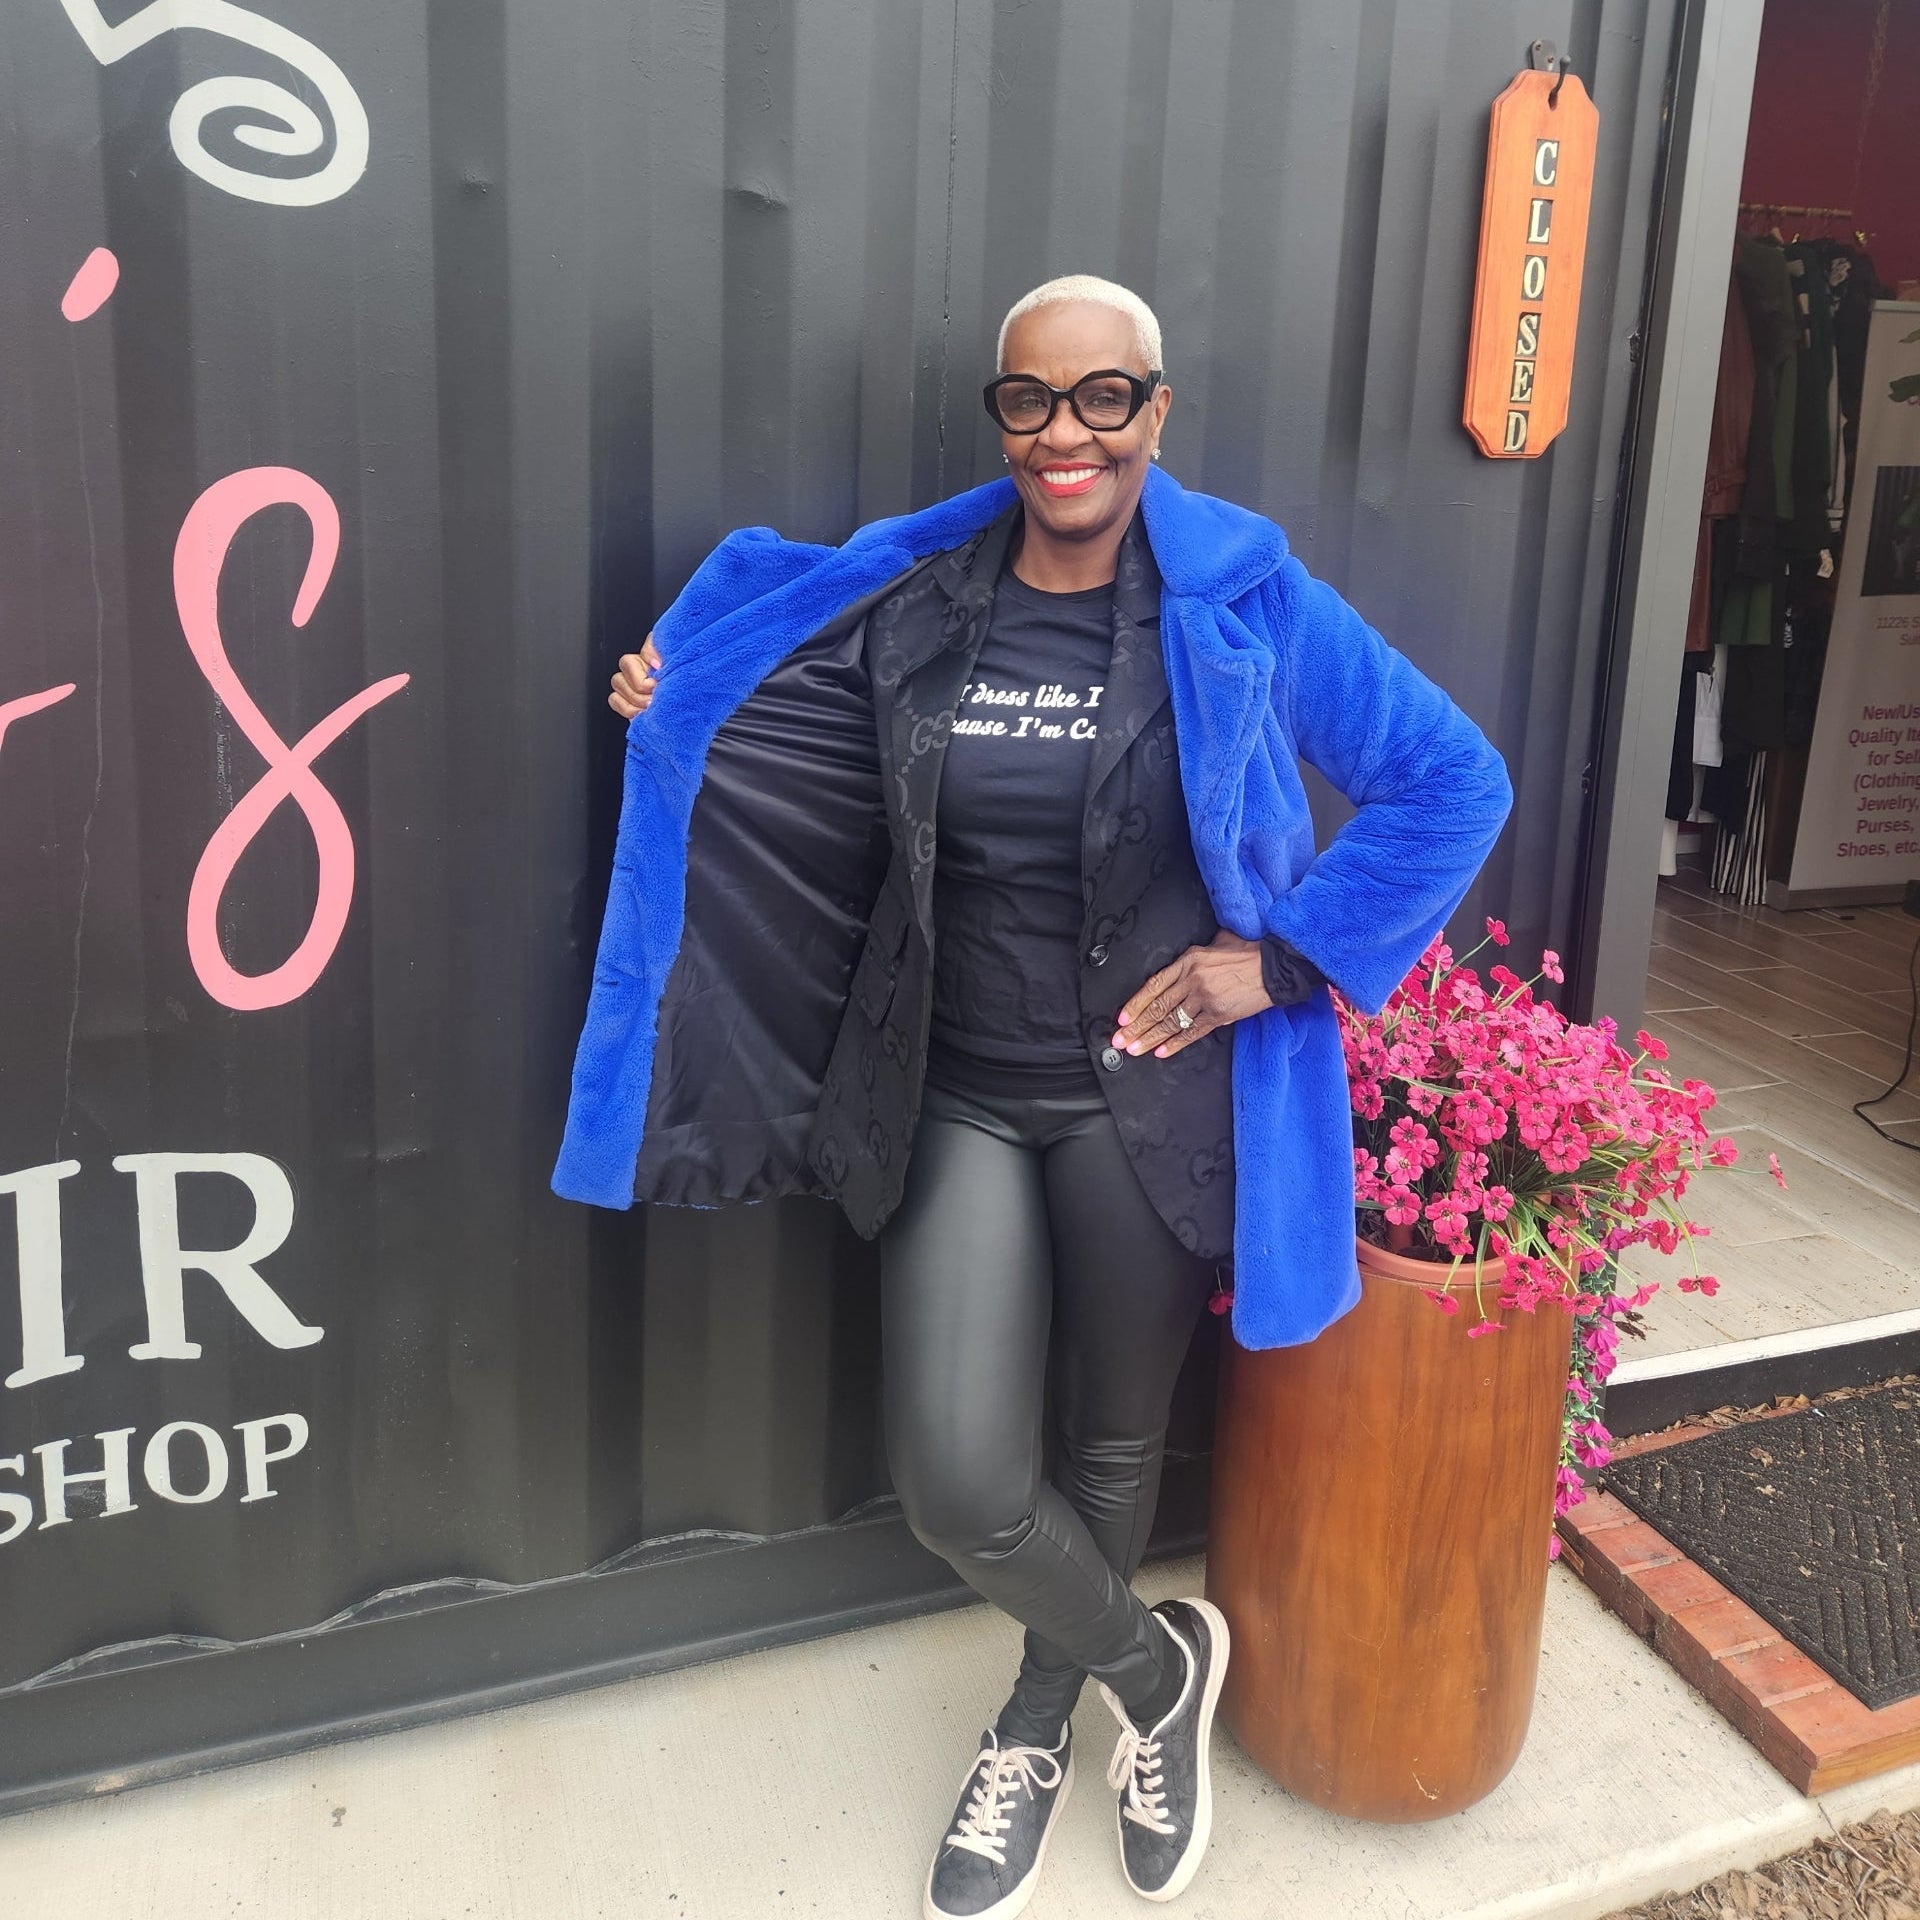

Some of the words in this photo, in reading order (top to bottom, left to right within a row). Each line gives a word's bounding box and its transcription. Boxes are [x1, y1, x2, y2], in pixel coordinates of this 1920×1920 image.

[1503, 140, 1558, 452] CLOSED
[971, 683, 1030, 706] dress
[1034, 684, 1080, 707] like
[1083, 686, 1104, 707] I
[1011, 716, 1065, 738] I'm
[1849, 728, 1903, 748] Quality
[1868, 750, 1890, 767] for
[1857, 795, 1919, 813] Jewelry,
[1856, 819, 1914, 834] Purses,
[1837, 842, 1889, 857] Shoes,
